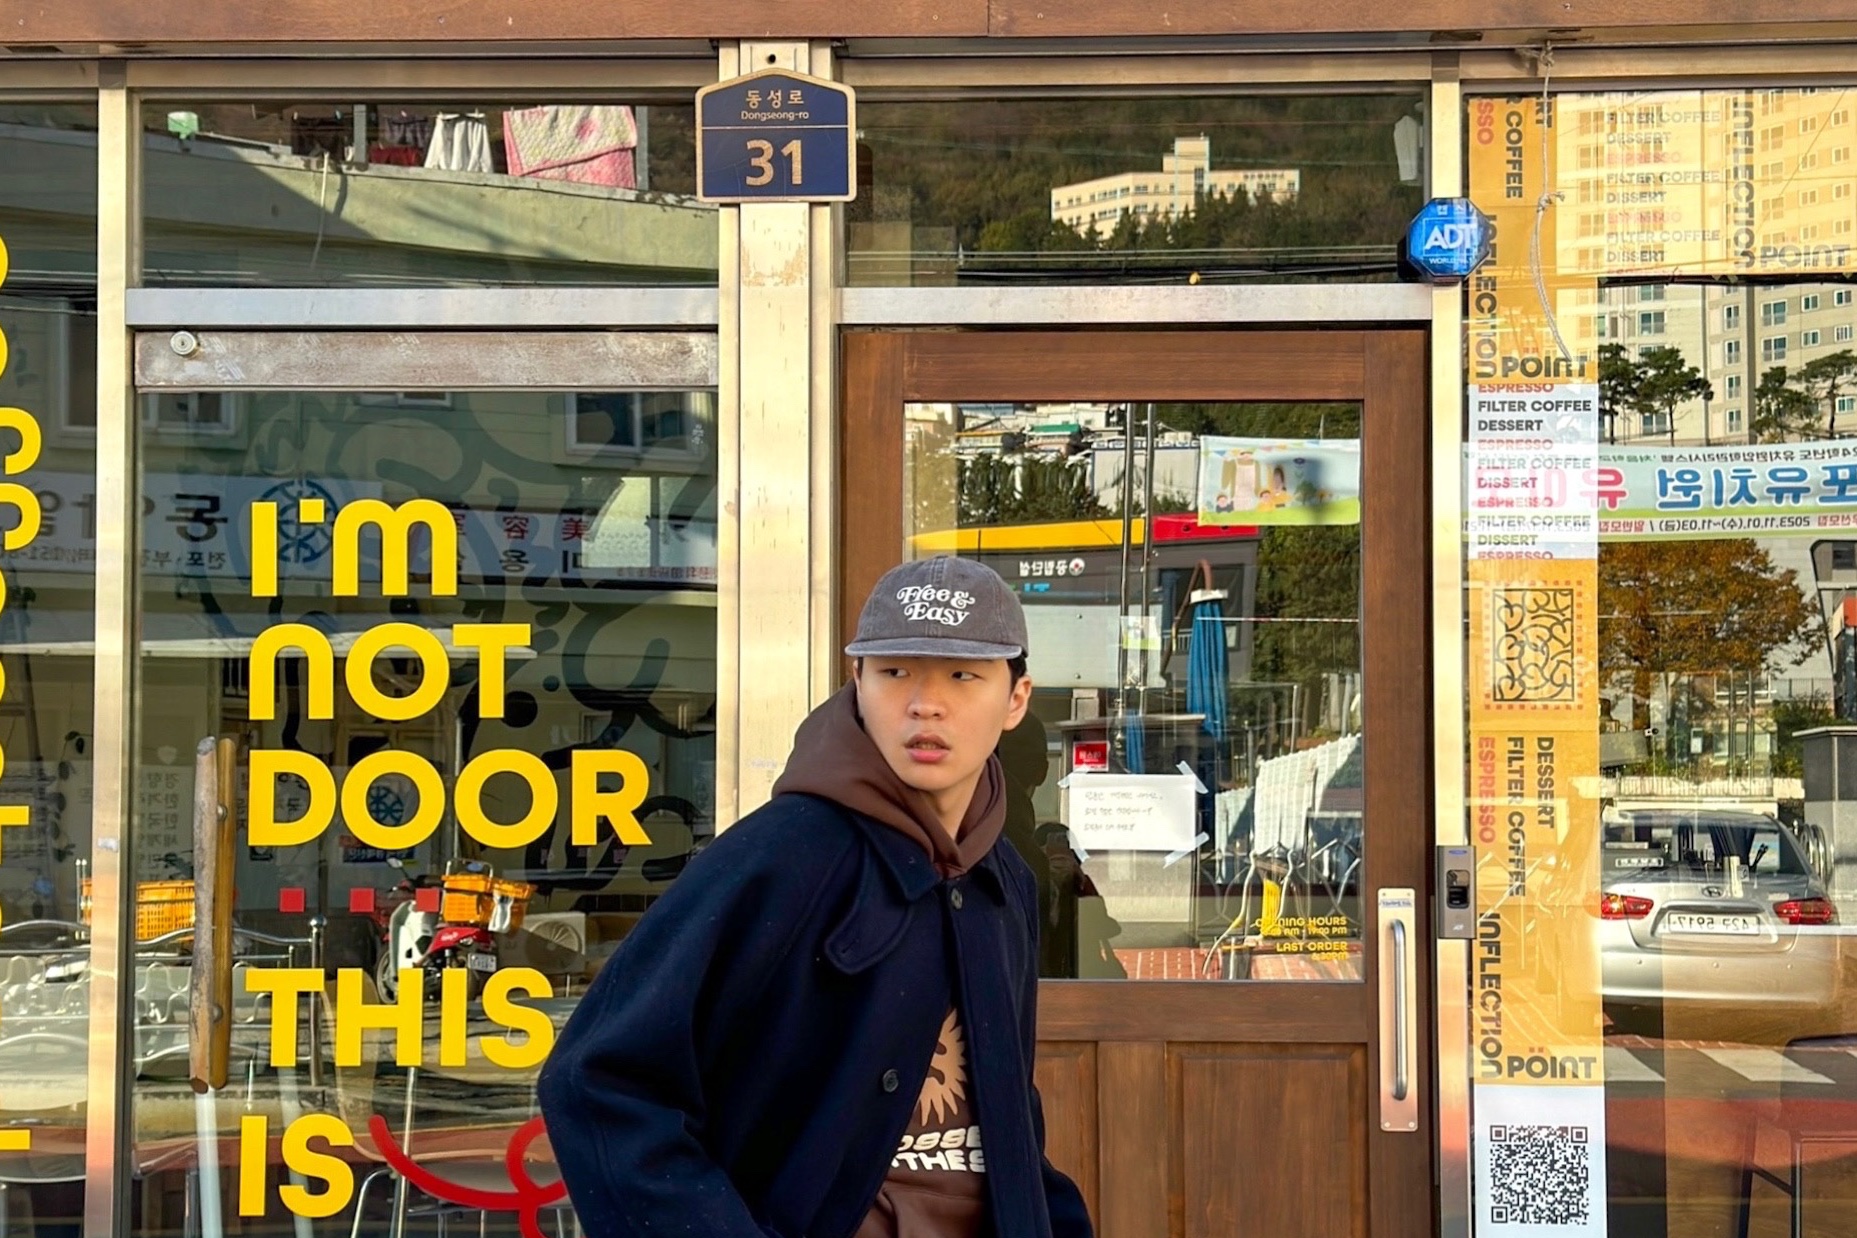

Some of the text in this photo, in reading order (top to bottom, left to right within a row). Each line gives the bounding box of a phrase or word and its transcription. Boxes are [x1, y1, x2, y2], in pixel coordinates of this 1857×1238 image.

[745, 89, 805, 109] 동성로
[741, 110, 809, 122] Dongseong-ro
[1477, 97, 1494, 146] SSO
[1659, 110, 1720, 123] COFFEE
[745, 139, 803, 186] 31
[1506, 111, 1523, 199] COFFEE
[1659, 171, 1720, 183] COFFEE
[1425, 224, 1477, 250] ADT
[1606, 230, 1720, 244] FILTER COFFEE
[1478, 400, 1592, 412] FILTER COFFEE
[1478, 420, 1543, 431] DESSERT
[1478, 439, 1554, 450] ESPRESSO
[1478, 458, 1591, 470] FILTER COFFEE
[1478, 515, 1527, 527] FILTER
[1531, 515, 1591, 527] COFFEE
[896, 584, 976, 609] Free &
[903, 602, 970, 626] Easy
[1479, 736, 1496, 844] ESPRESSO
[1537, 736, 1555, 829] DESSERT
[246, 748, 653, 849] DOOR
[1507, 736, 1526, 897] FILTER COFFEE
[1308, 916, 1347, 926] HOURS
[1332, 926, 1347, 935] PM
[1276, 941, 1348, 952] LAST ORDER
[1479, 912, 1503, 1079] INFLECTION
[245, 967, 555, 1069] THIS
[238, 1114, 355, 1219] IS
[891, 1149, 987, 1173] THES
